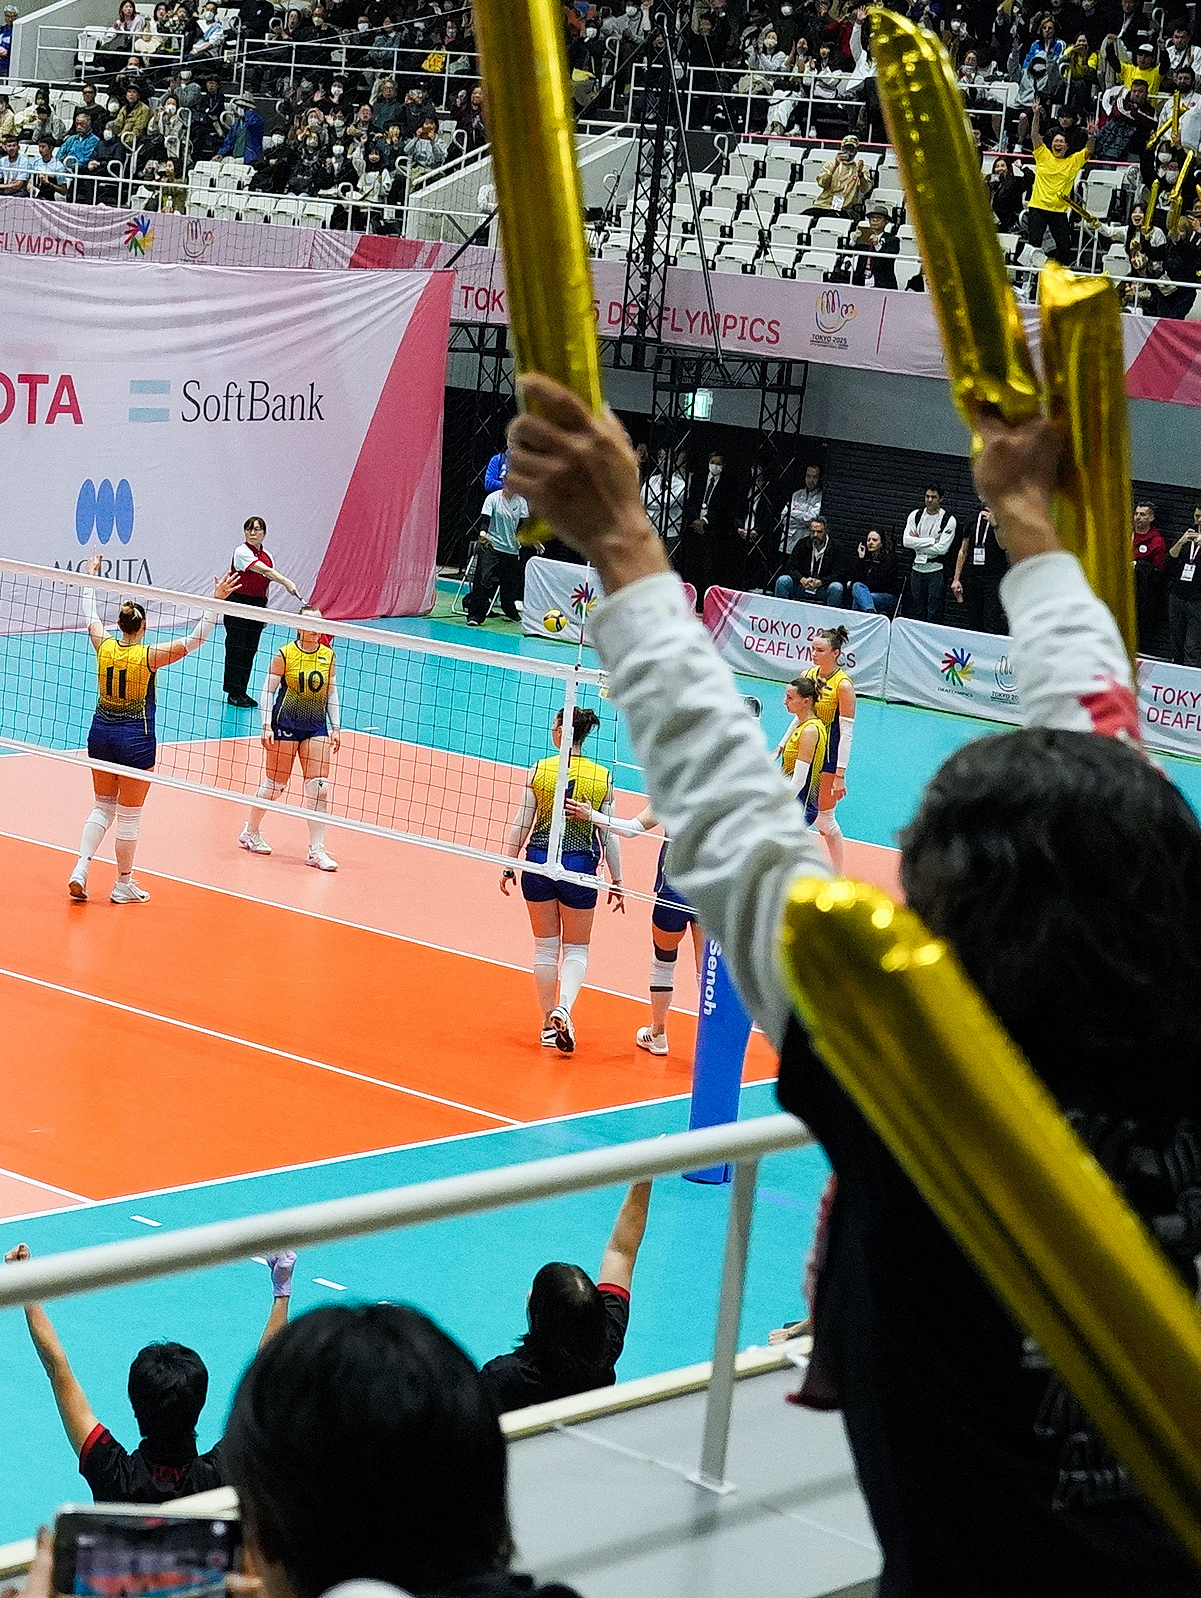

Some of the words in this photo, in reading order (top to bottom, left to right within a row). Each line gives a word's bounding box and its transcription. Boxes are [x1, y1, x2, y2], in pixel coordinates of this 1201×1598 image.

[180, 379, 325, 424] SoftBank
[749, 615, 802, 639] TOKYO
[106, 666, 127, 699] 11
[298, 670, 324, 693] 10
[703, 939, 723, 1016] Senoh
